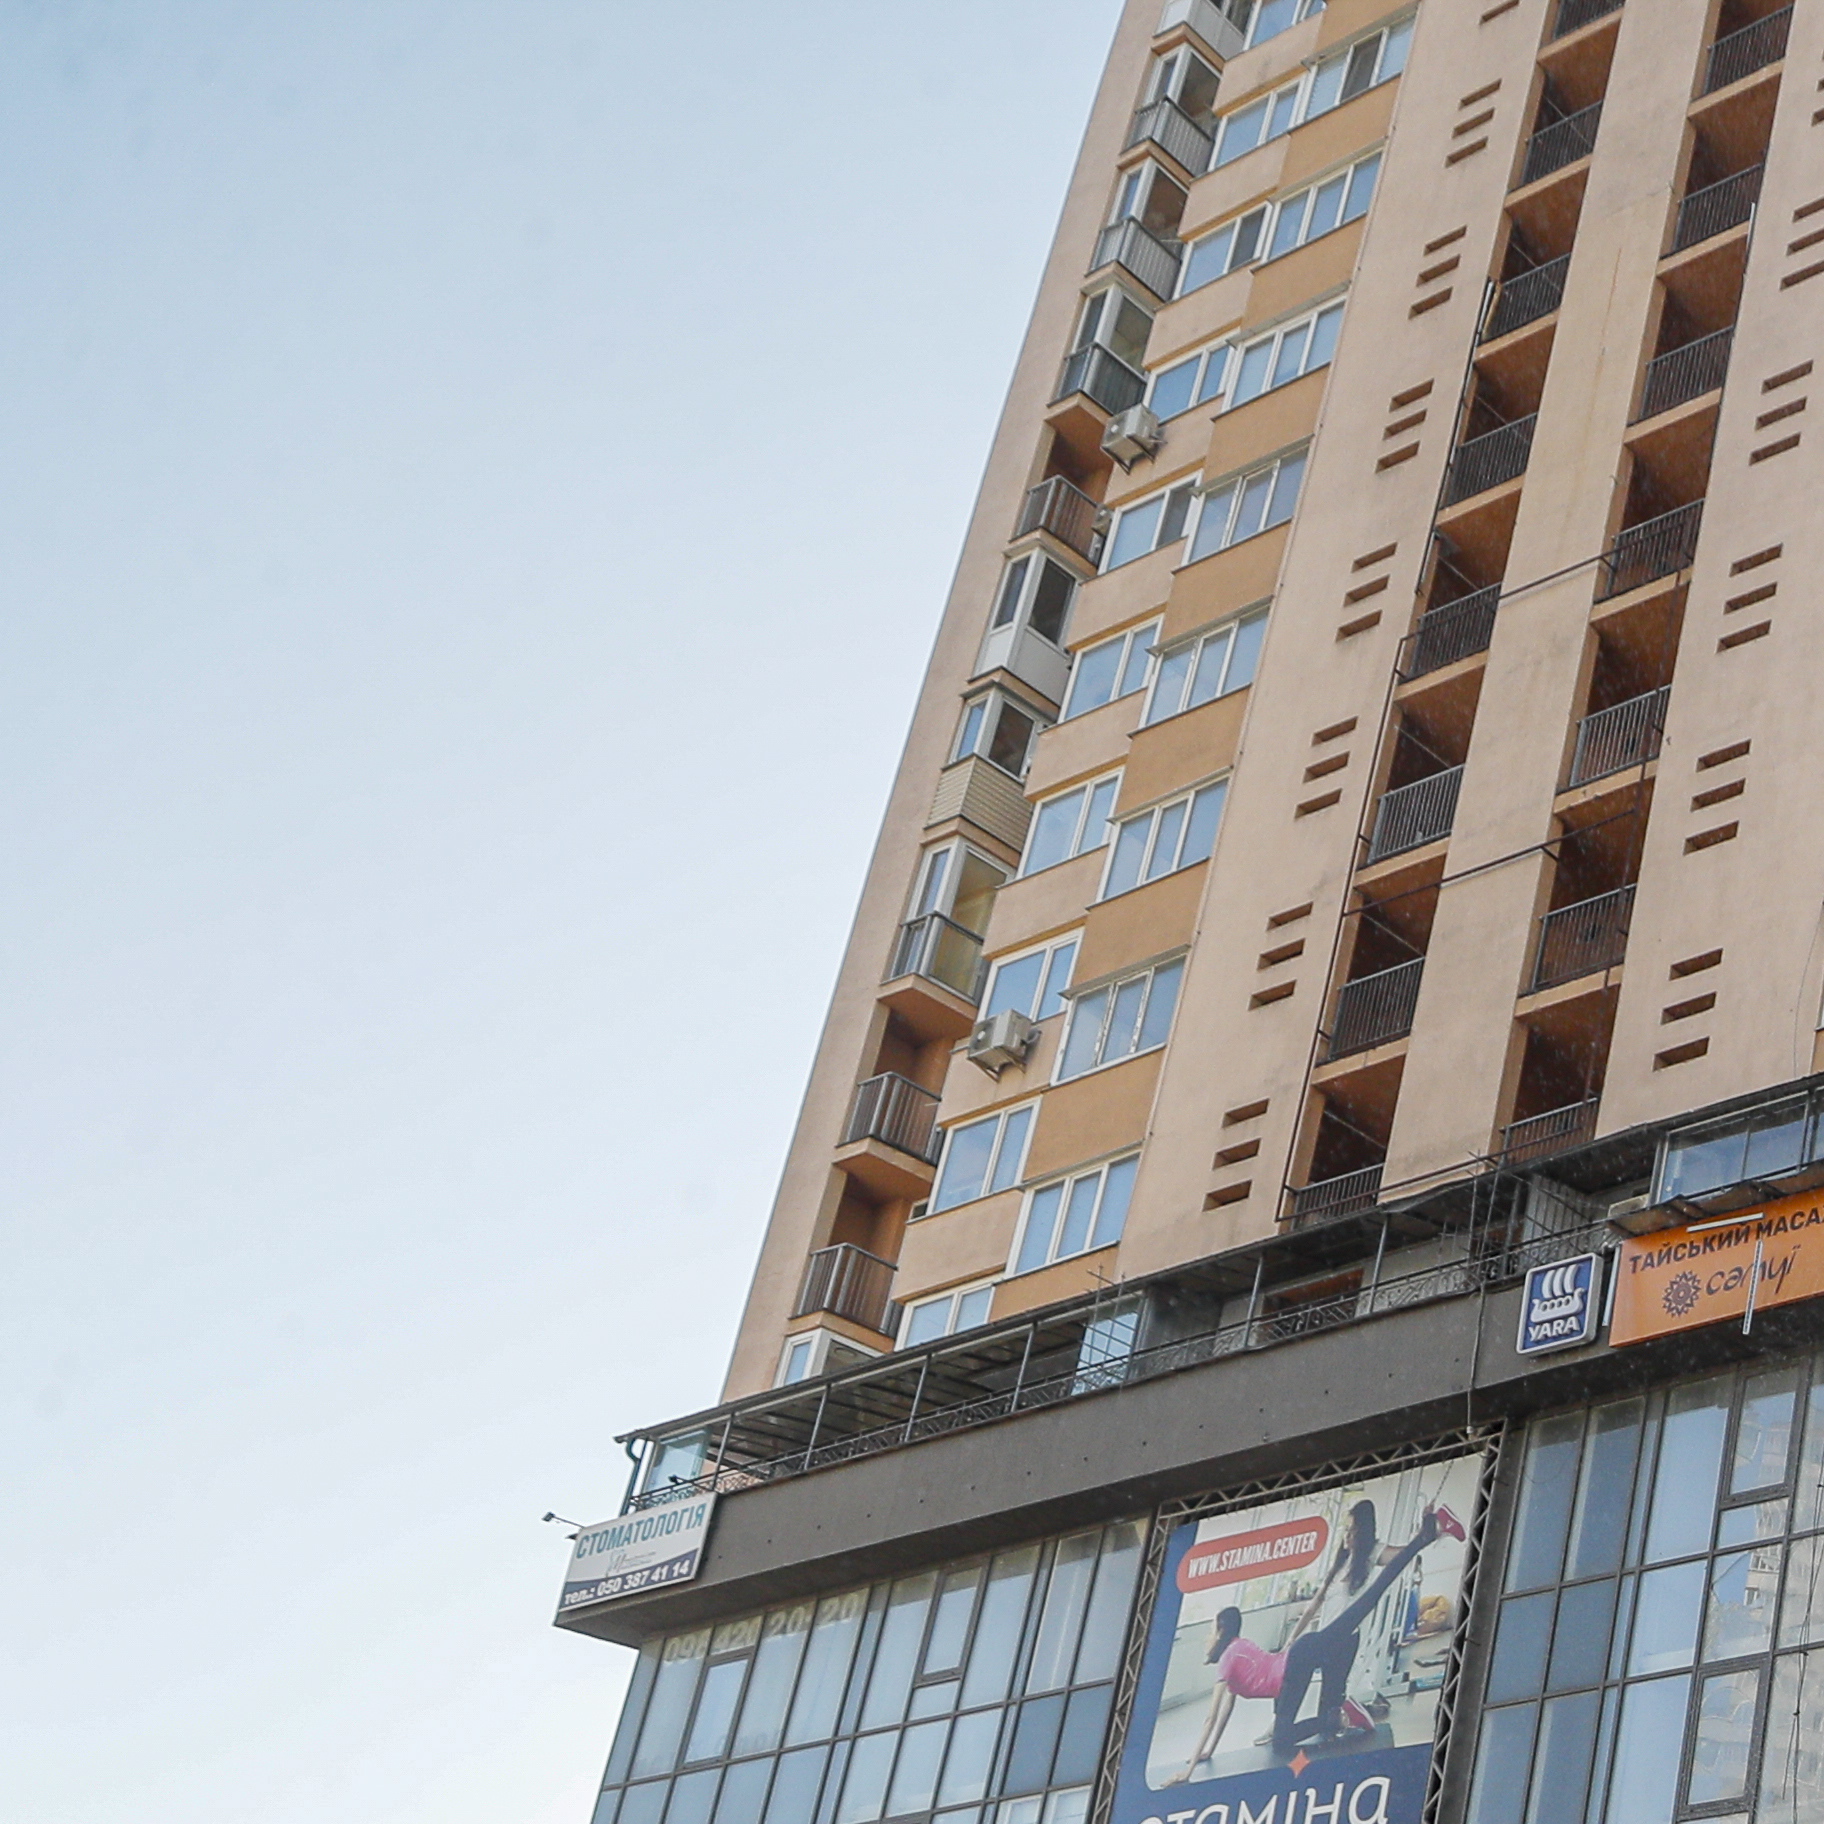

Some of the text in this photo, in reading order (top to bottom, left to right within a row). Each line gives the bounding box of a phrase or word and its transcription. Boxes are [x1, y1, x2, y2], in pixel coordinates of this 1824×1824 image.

[1629, 1221, 1754, 1274] ТАЙСЬКИЙ
[1528, 1314, 1580, 1342] YARA
[575, 1502, 708, 1559] СТОМАТОЛОГІЯ
[1188, 1531, 1318, 1579] WWW.STAMINA.CENTER
[564, 1587, 595, 1606] тел.:
[598, 1576, 621, 1597] 050
[624, 1570, 649, 1592] 387
[650, 1565, 669, 1583] 41
[671, 1559, 689, 1577] 14
